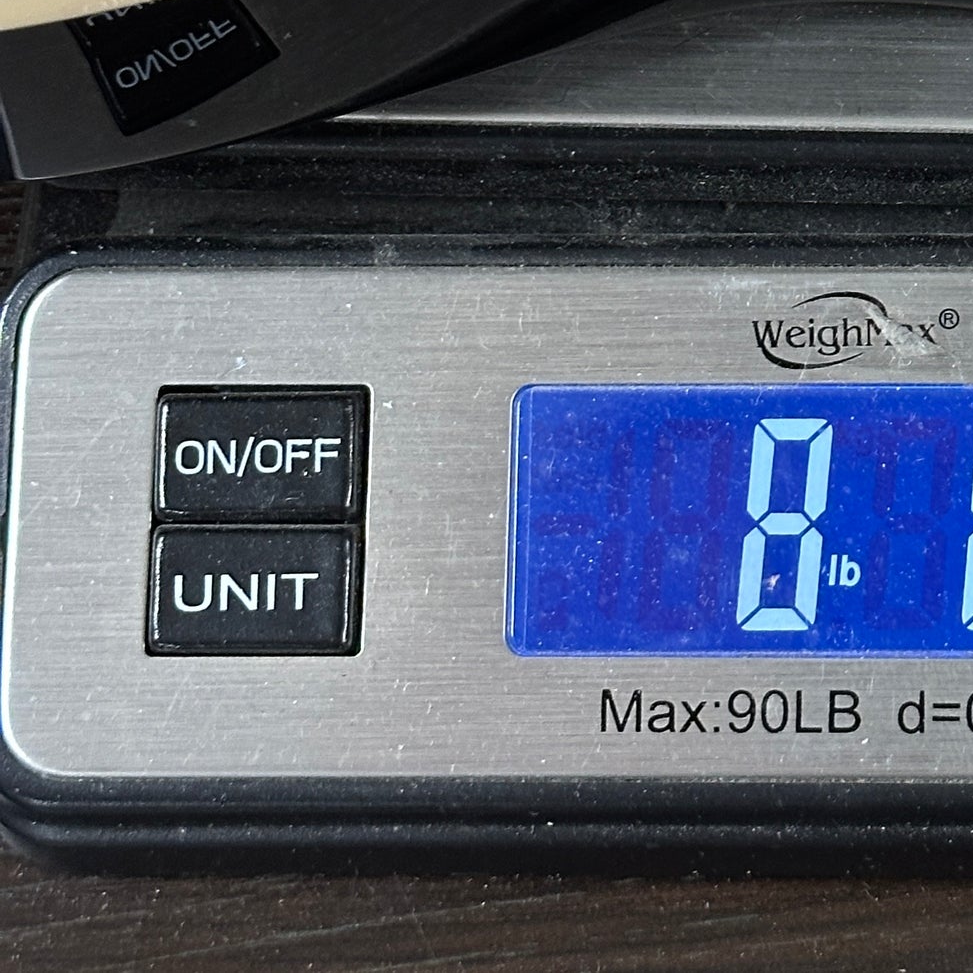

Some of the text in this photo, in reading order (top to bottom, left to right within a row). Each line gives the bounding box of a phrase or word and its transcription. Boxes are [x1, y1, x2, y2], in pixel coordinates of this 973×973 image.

[175, 436, 341, 477] ON/OFF
[736, 418, 832, 631] 8
[829, 555, 861, 587] lb
[174, 573, 319, 612] UNIT
[600, 689, 861, 734] Max:90LB
